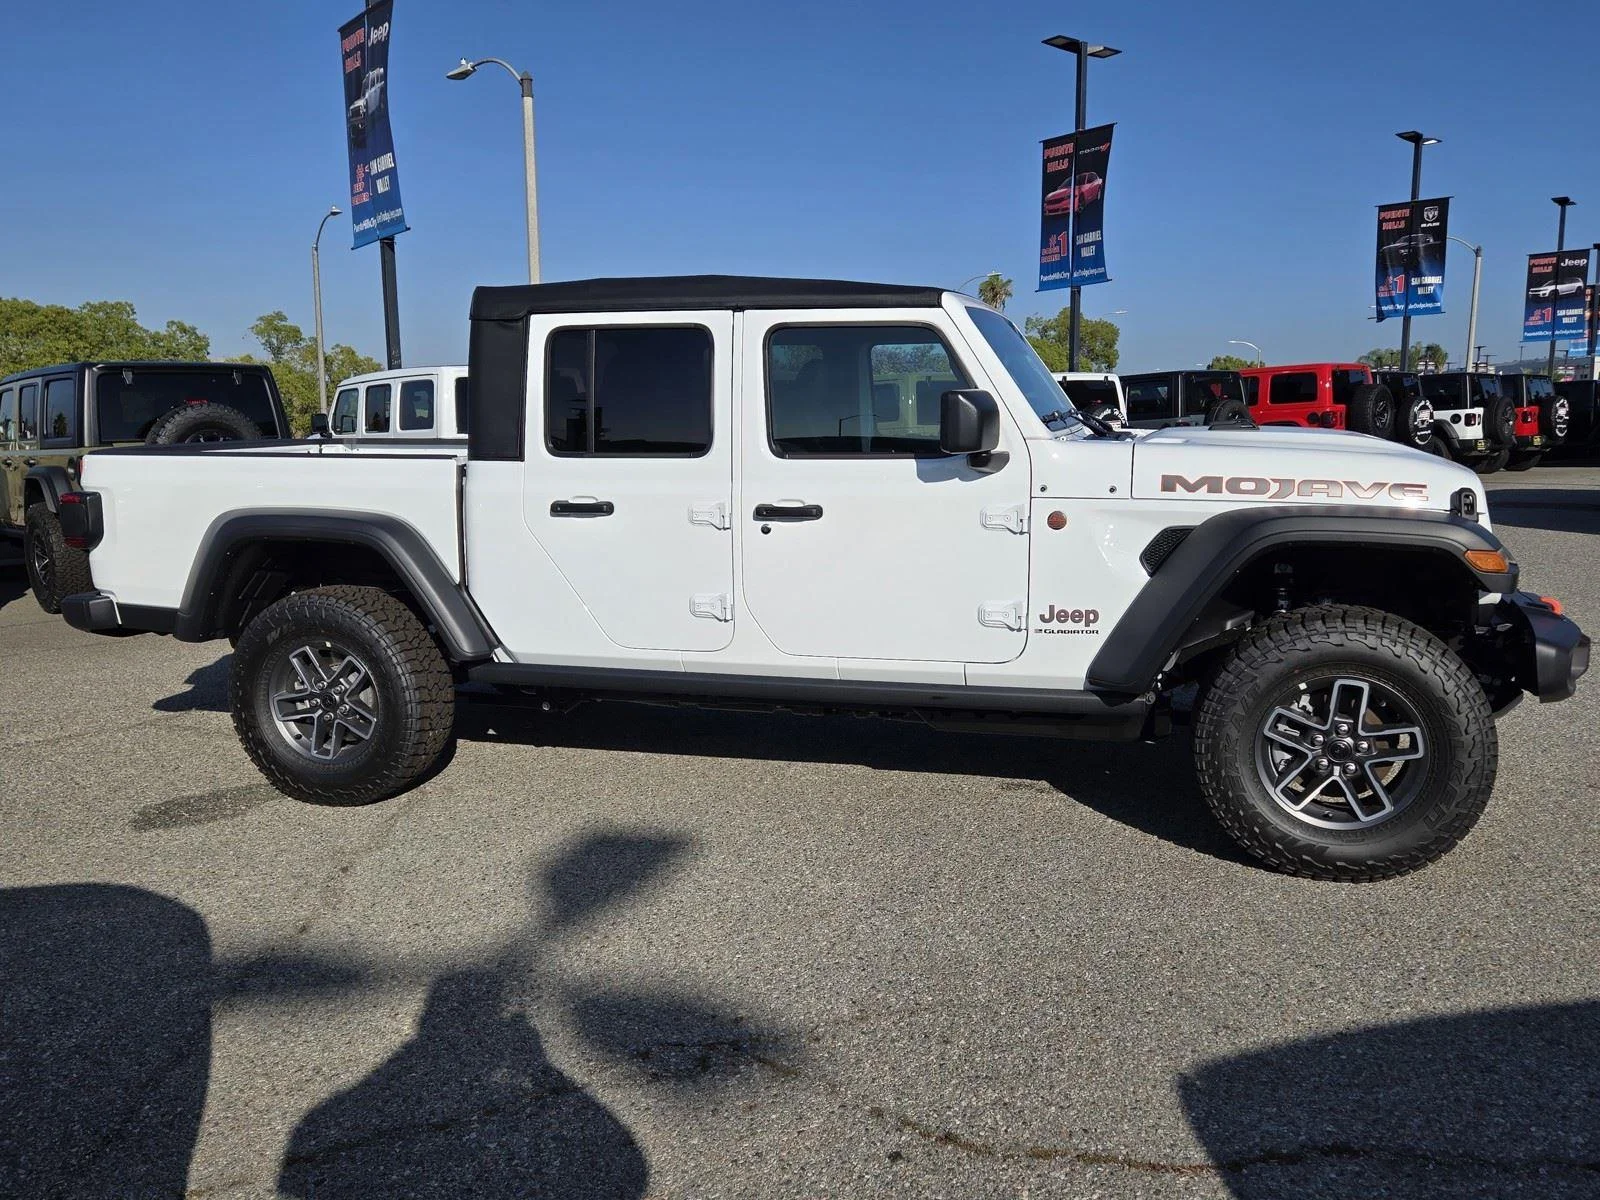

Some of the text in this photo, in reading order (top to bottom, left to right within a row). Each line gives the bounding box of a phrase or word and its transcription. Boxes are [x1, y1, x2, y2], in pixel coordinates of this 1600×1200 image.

[368, 21, 389, 47] Jeep
[1047, 158, 1069, 173] HILLS
[1382, 220, 1405, 230] HILLS
[1049, 231, 1067, 257] #1
[1081, 245, 1096, 258] VALLEY
[1560, 258, 1588, 267] Jeep
[1161, 474, 1428, 502] MOJAVE
[1039, 604, 1100, 628] Jeep
